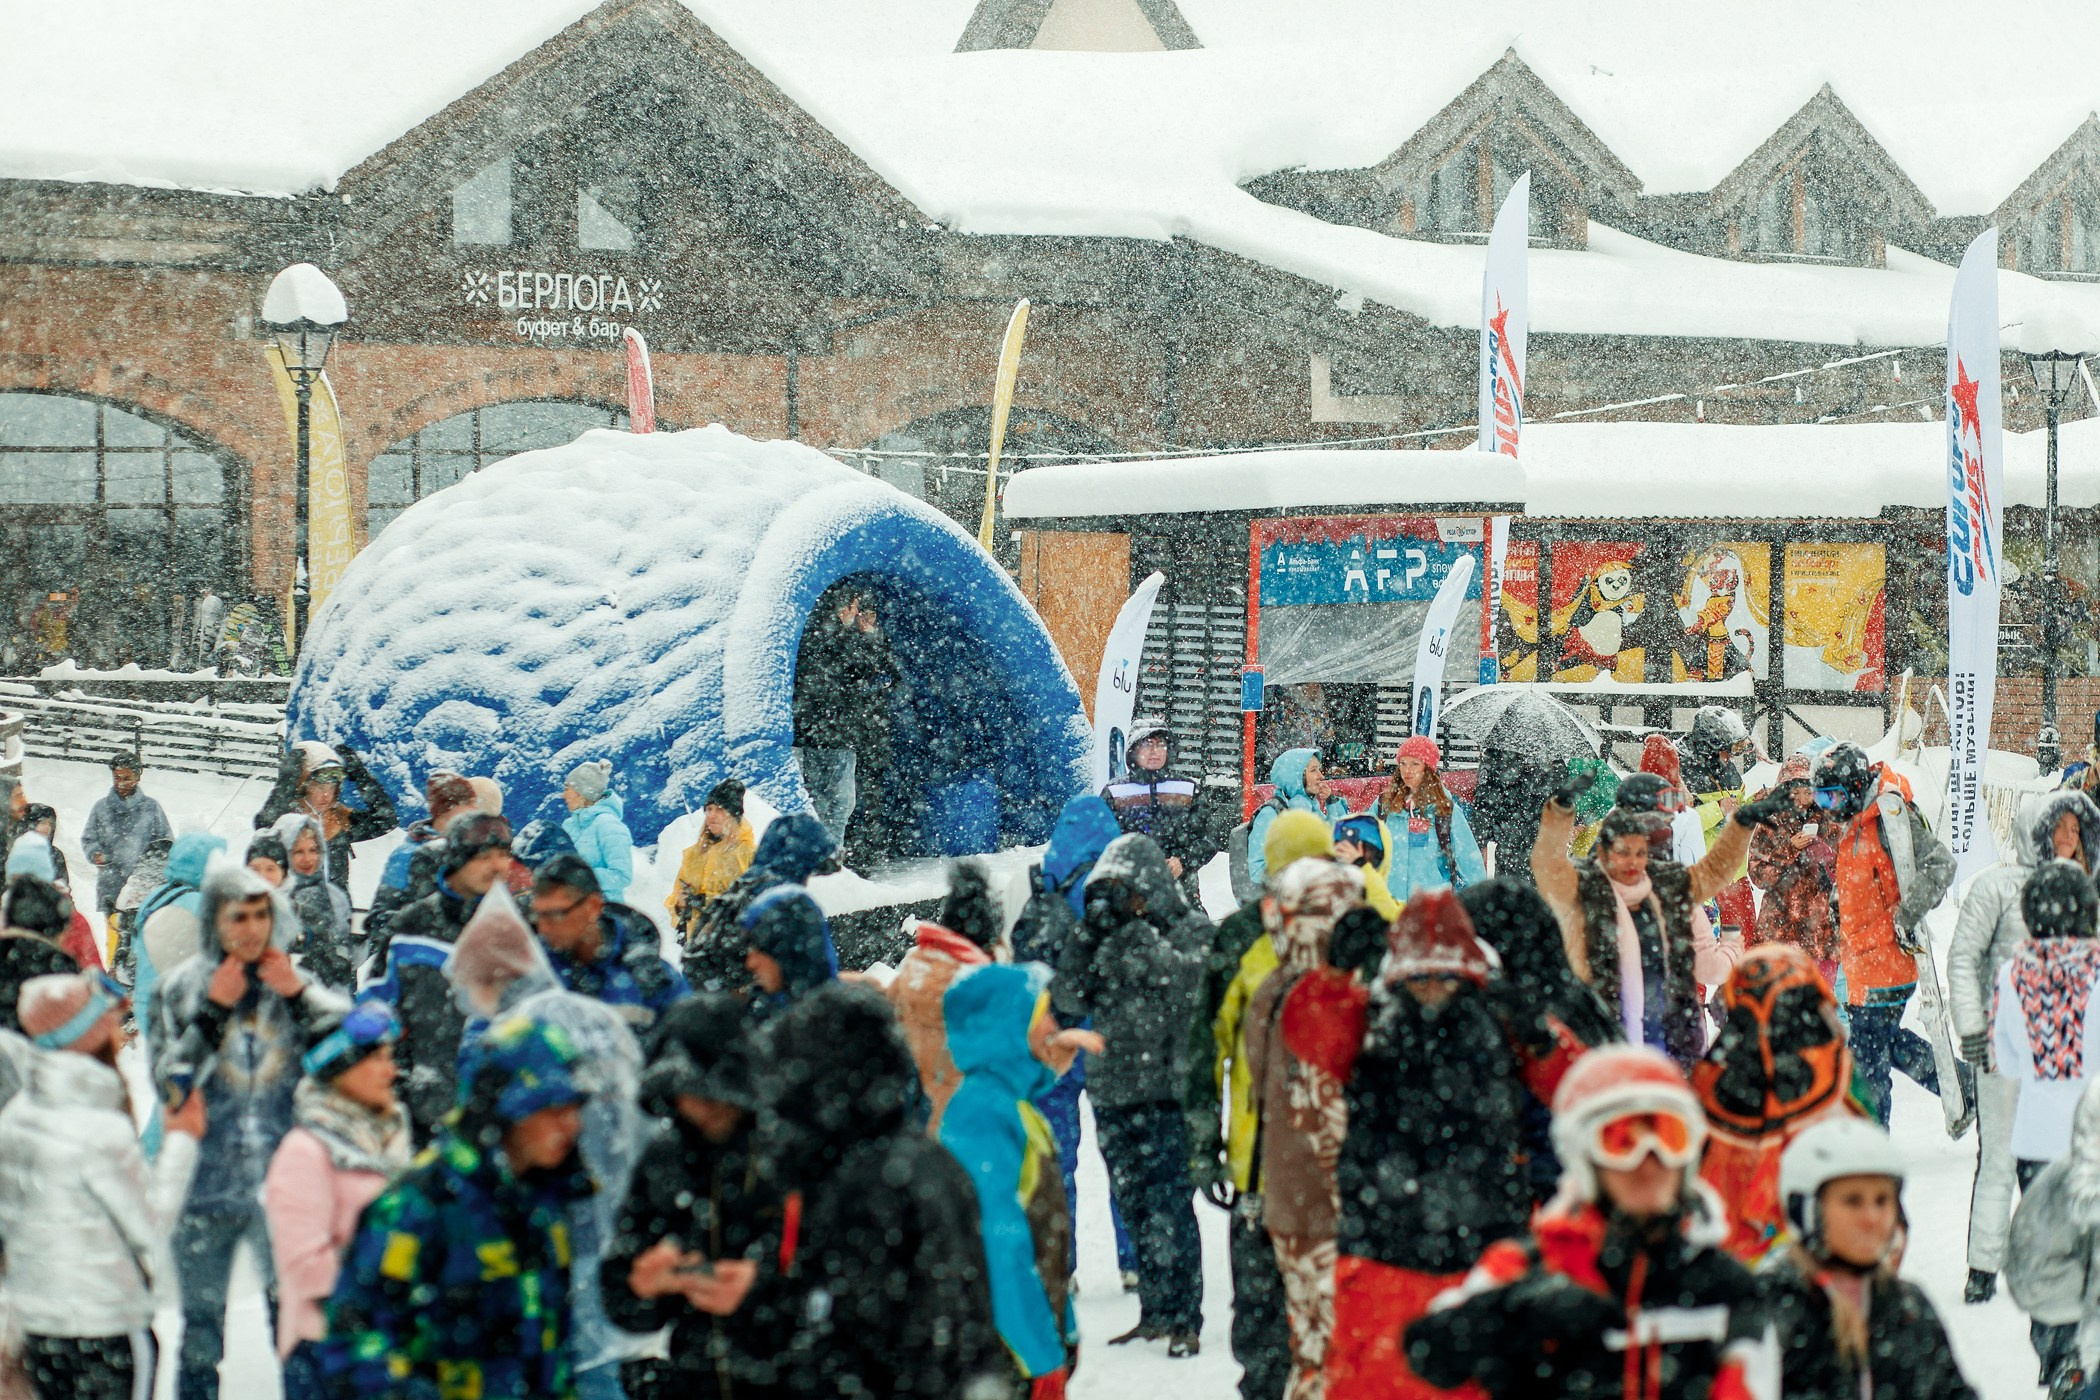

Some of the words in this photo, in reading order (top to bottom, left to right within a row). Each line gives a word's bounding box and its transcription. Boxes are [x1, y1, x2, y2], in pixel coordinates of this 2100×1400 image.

[498, 270, 634, 313] БЕРЛОГА
[517, 316, 568, 341] буфет
[572, 317, 585, 336] &
[589, 316, 620, 343] бар
[1343, 549, 1427, 592] AFP
[1429, 635, 1444, 658] blu
[1113, 667, 1132, 693] blu
